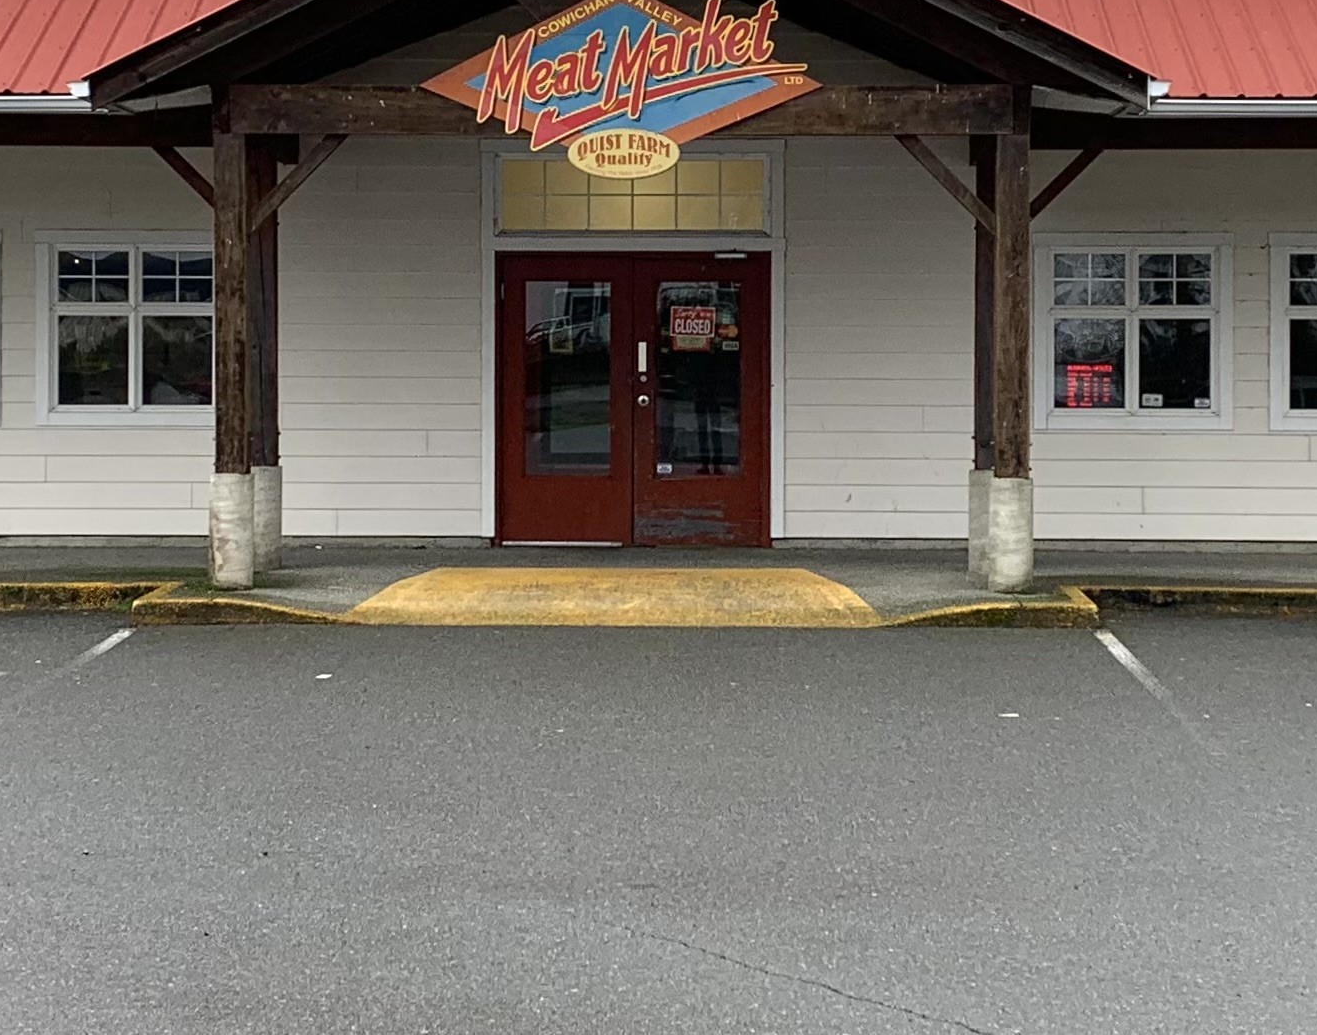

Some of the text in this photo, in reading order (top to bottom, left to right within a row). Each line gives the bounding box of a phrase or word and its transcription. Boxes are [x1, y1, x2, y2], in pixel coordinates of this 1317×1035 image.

[477, 28, 606, 134] Meat
[784, 76, 804, 85] LTD
[577, 133, 670, 161] QUIST FARM
[595, 152, 653, 167] Quality
[674, 318, 711, 334] CLOSED
